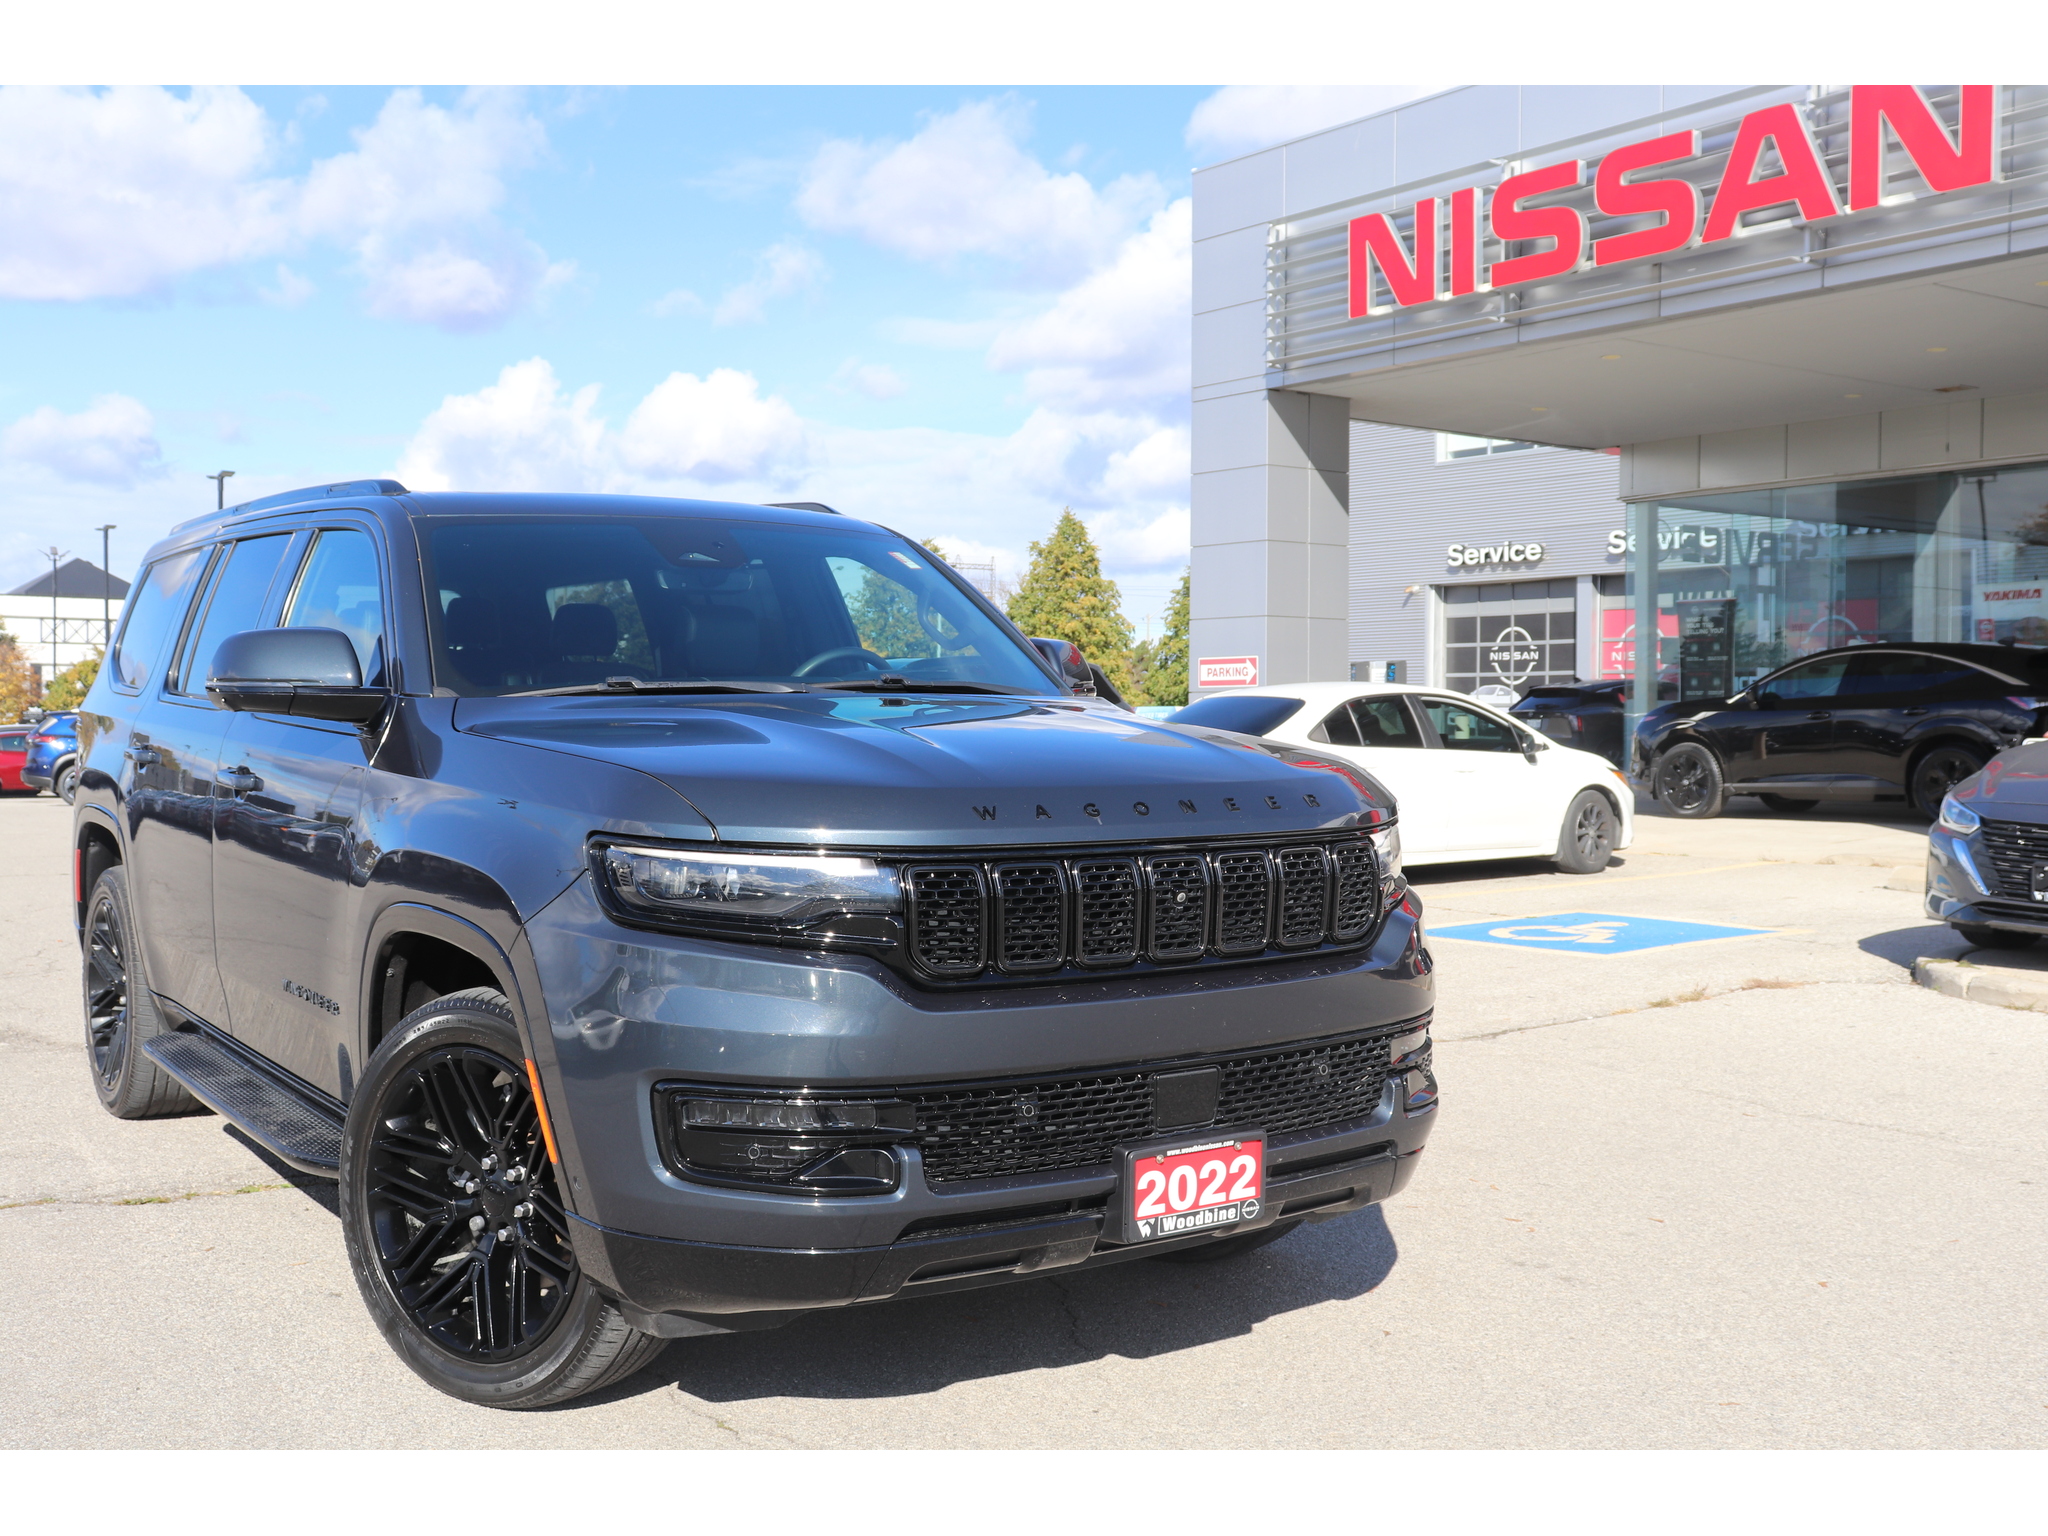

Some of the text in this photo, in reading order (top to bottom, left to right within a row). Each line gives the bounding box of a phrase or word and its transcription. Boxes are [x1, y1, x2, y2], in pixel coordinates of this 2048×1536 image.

[1347, 85, 2001, 319] NISSAN
[1446, 541, 1543, 567] Service
[1983, 588, 2043, 601] YAKIMA
[1489, 650, 1539, 661] NISSAN
[1206, 666, 1249, 678] PARKING
[972, 793, 1321, 821] WAGONEER
[1136, 1154, 1257, 1218] 2022
[1161, 1206, 1237, 1232] Woodbine
